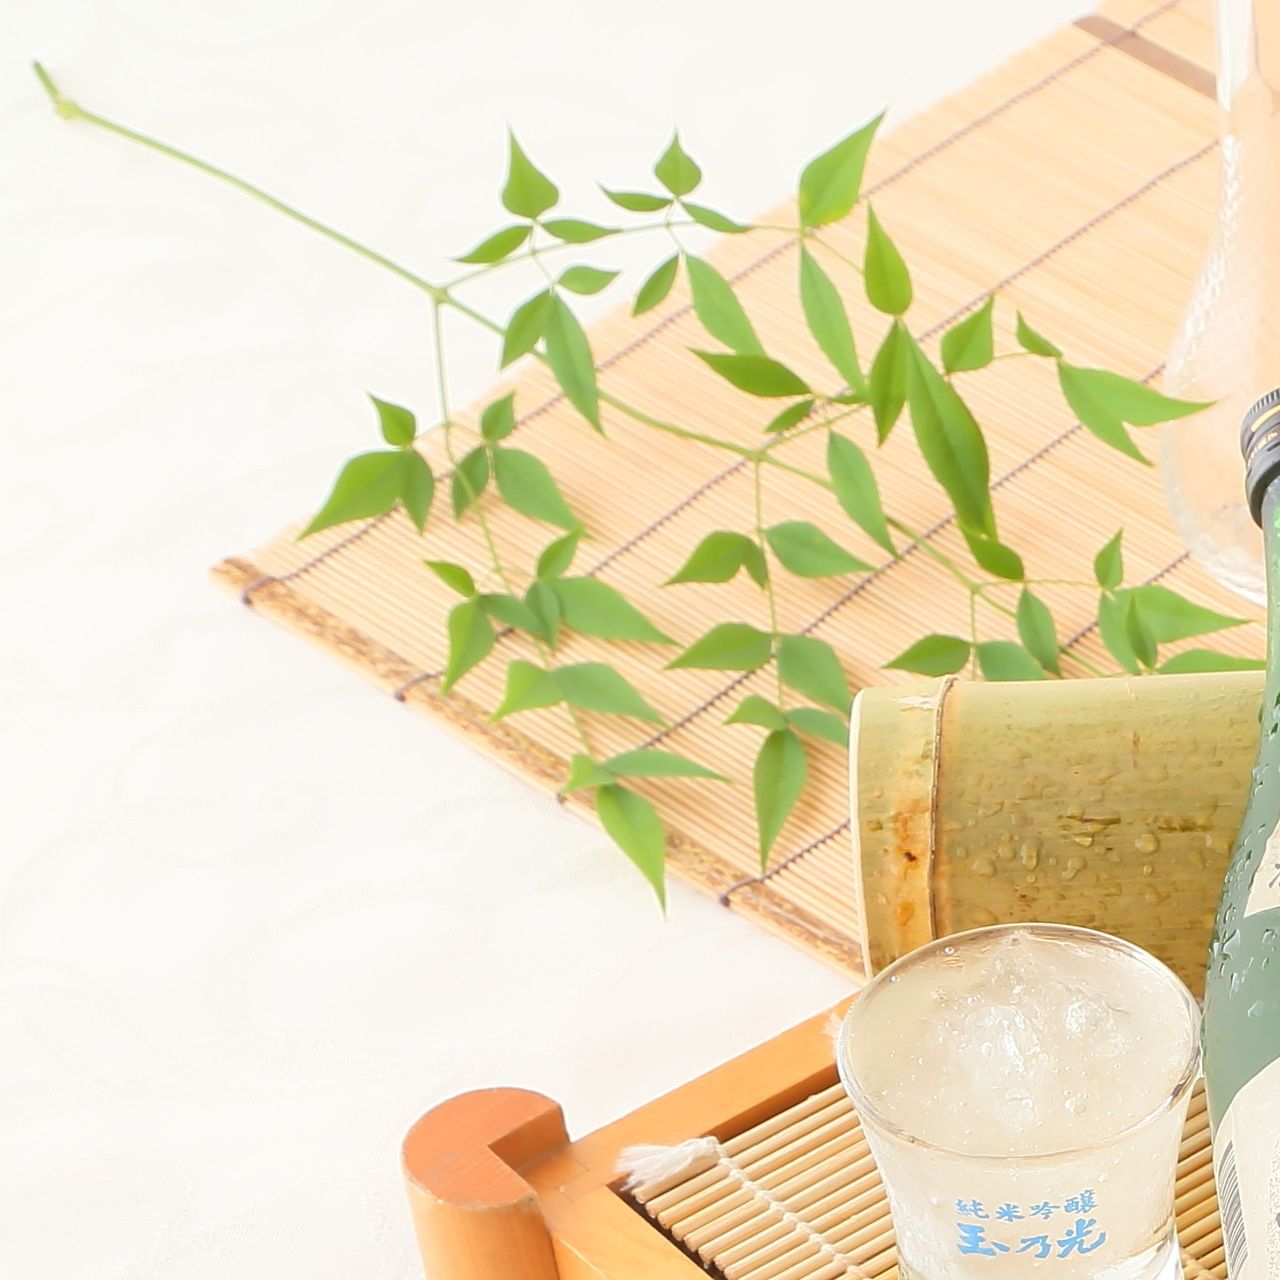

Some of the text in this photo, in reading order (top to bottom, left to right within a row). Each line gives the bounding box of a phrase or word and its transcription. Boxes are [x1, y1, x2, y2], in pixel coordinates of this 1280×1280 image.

[955, 1189, 1098, 1222] 純米吟醸
[955, 1218, 1107, 1260] 玉乃光
